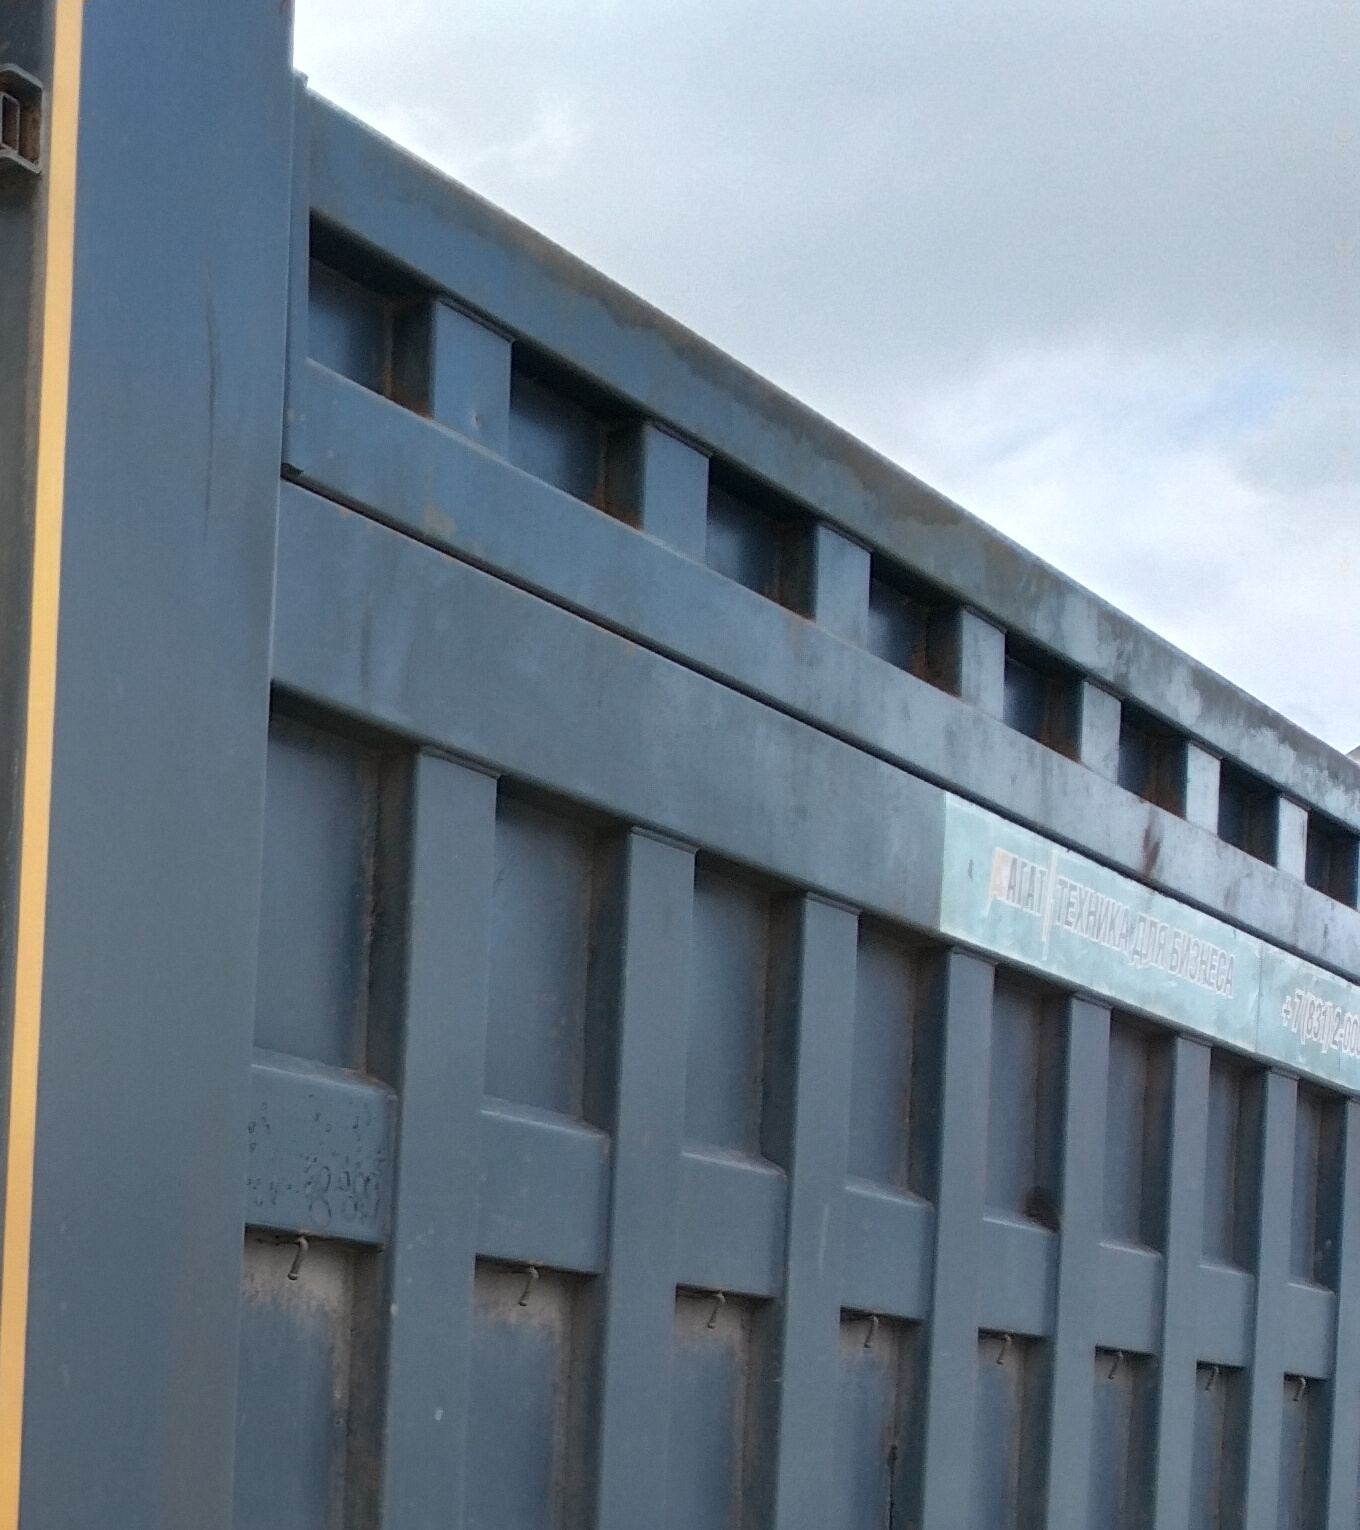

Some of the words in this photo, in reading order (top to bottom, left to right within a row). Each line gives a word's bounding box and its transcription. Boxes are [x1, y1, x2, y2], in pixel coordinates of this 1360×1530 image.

[1007, 856, 1047, 917] АГАТ
[1054, 878, 1130, 952] ТЕХНИКА
[1130, 911, 1170, 968] ДЛЯ
[1170, 930, 1235, 998] БИЗНЕСА
